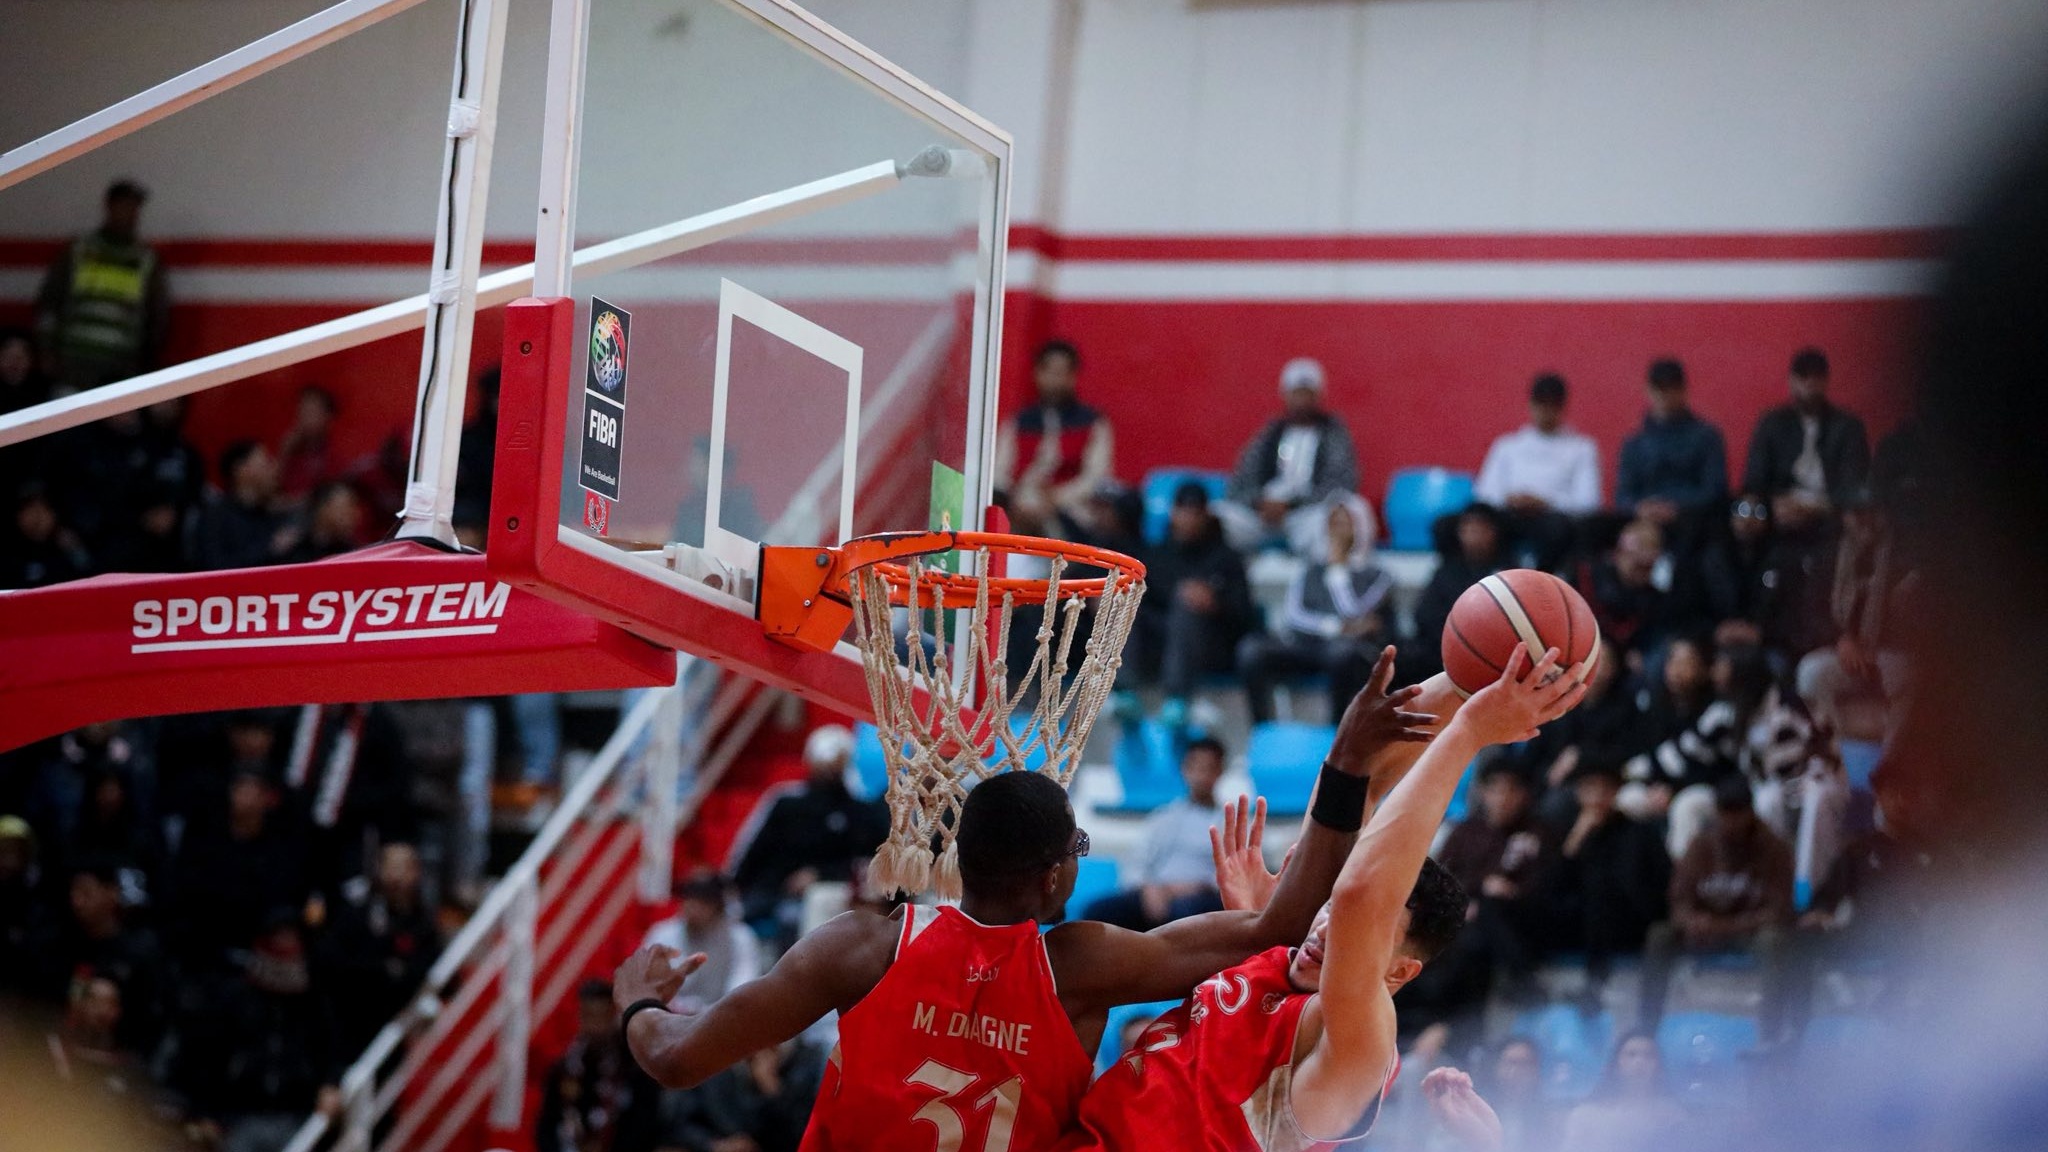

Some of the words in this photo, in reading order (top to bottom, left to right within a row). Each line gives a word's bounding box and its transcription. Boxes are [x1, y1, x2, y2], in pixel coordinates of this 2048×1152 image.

[589, 409, 617, 448] FIBA
[584, 464, 592, 476] We
[591, 467, 599, 479] Are
[912, 1001, 939, 1037] M.
[946, 1011, 1032, 1056] DIAGNE
[903, 1057, 1025, 1152] 31
